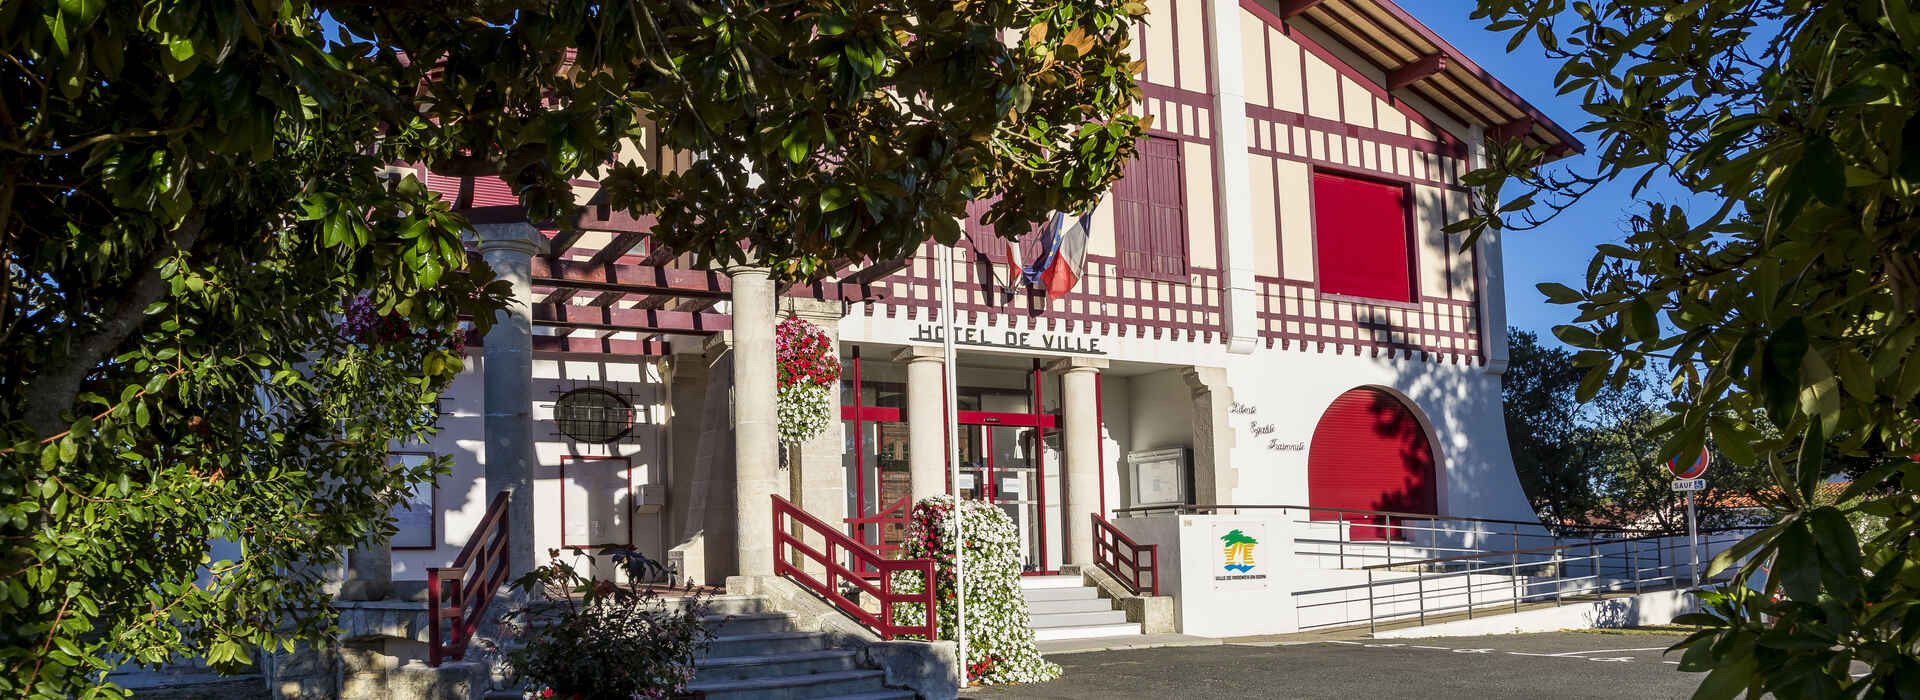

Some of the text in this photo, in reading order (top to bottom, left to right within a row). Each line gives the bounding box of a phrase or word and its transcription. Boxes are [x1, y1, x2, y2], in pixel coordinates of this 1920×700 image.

[918, 324, 1100, 352] HOTEL DE VILLE
